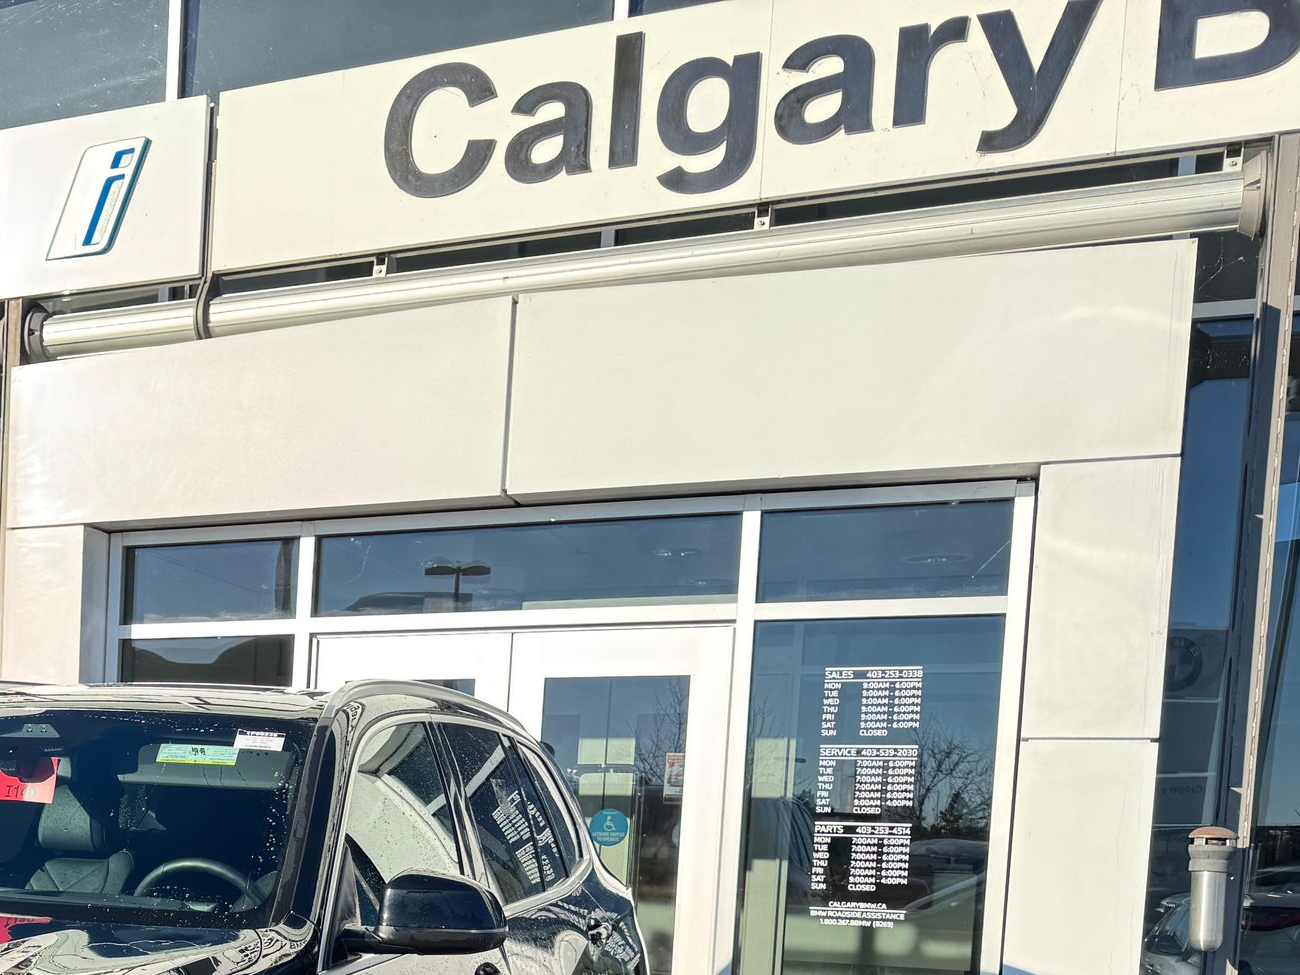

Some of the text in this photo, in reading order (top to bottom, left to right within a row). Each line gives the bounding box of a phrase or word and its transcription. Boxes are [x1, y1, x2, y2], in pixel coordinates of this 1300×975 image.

[383, 0, 1101, 195] Calgary
[867, 670, 923, 678] 403-253-0338
[815, 825, 843, 833] PARTS
[862, 912, 904, 920] ASSISTANCE
